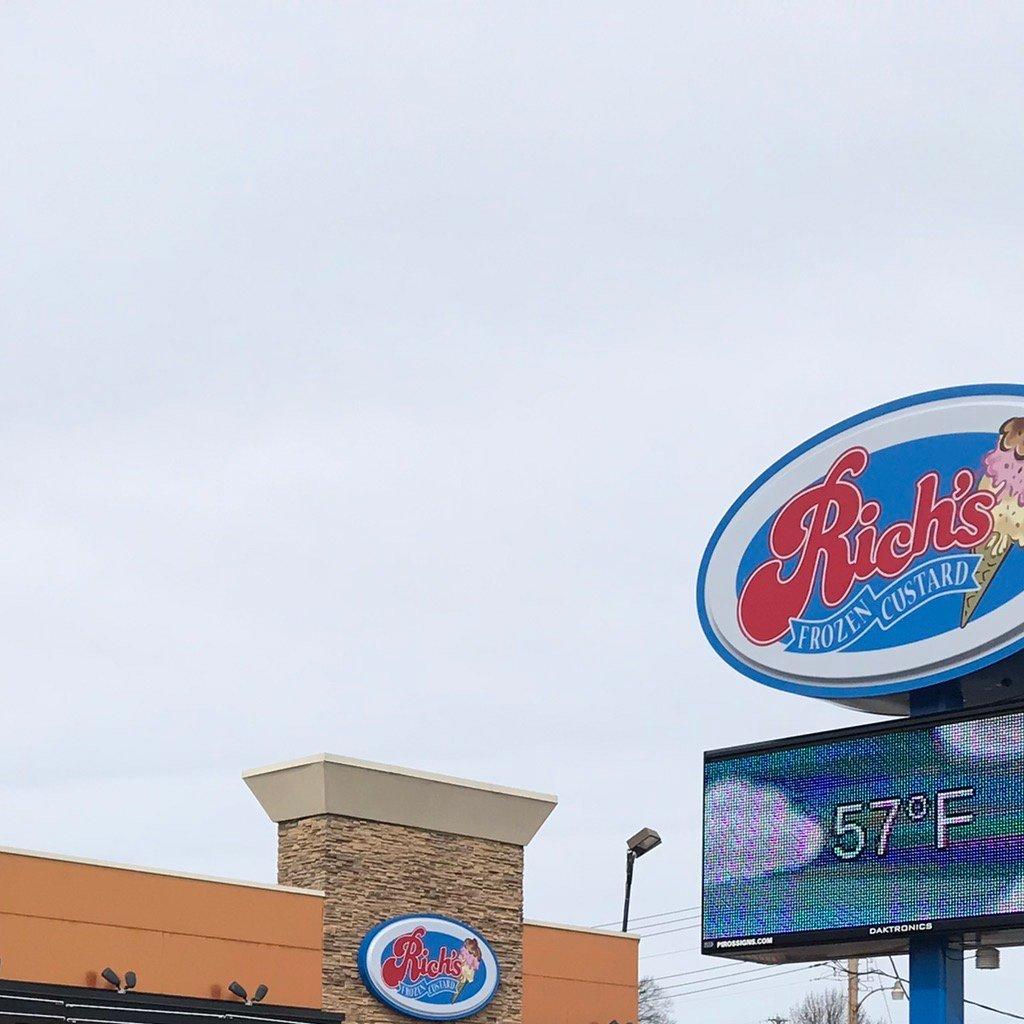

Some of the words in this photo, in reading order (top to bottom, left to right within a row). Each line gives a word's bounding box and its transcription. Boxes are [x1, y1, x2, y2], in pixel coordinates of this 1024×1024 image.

[737, 446, 996, 646] Rich's
[799, 600, 871, 650] FROZEN
[881, 560, 969, 621] CUSTARD
[382, 926, 463, 988] Rich's
[869, 922, 933, 935] DAKTRONICS
